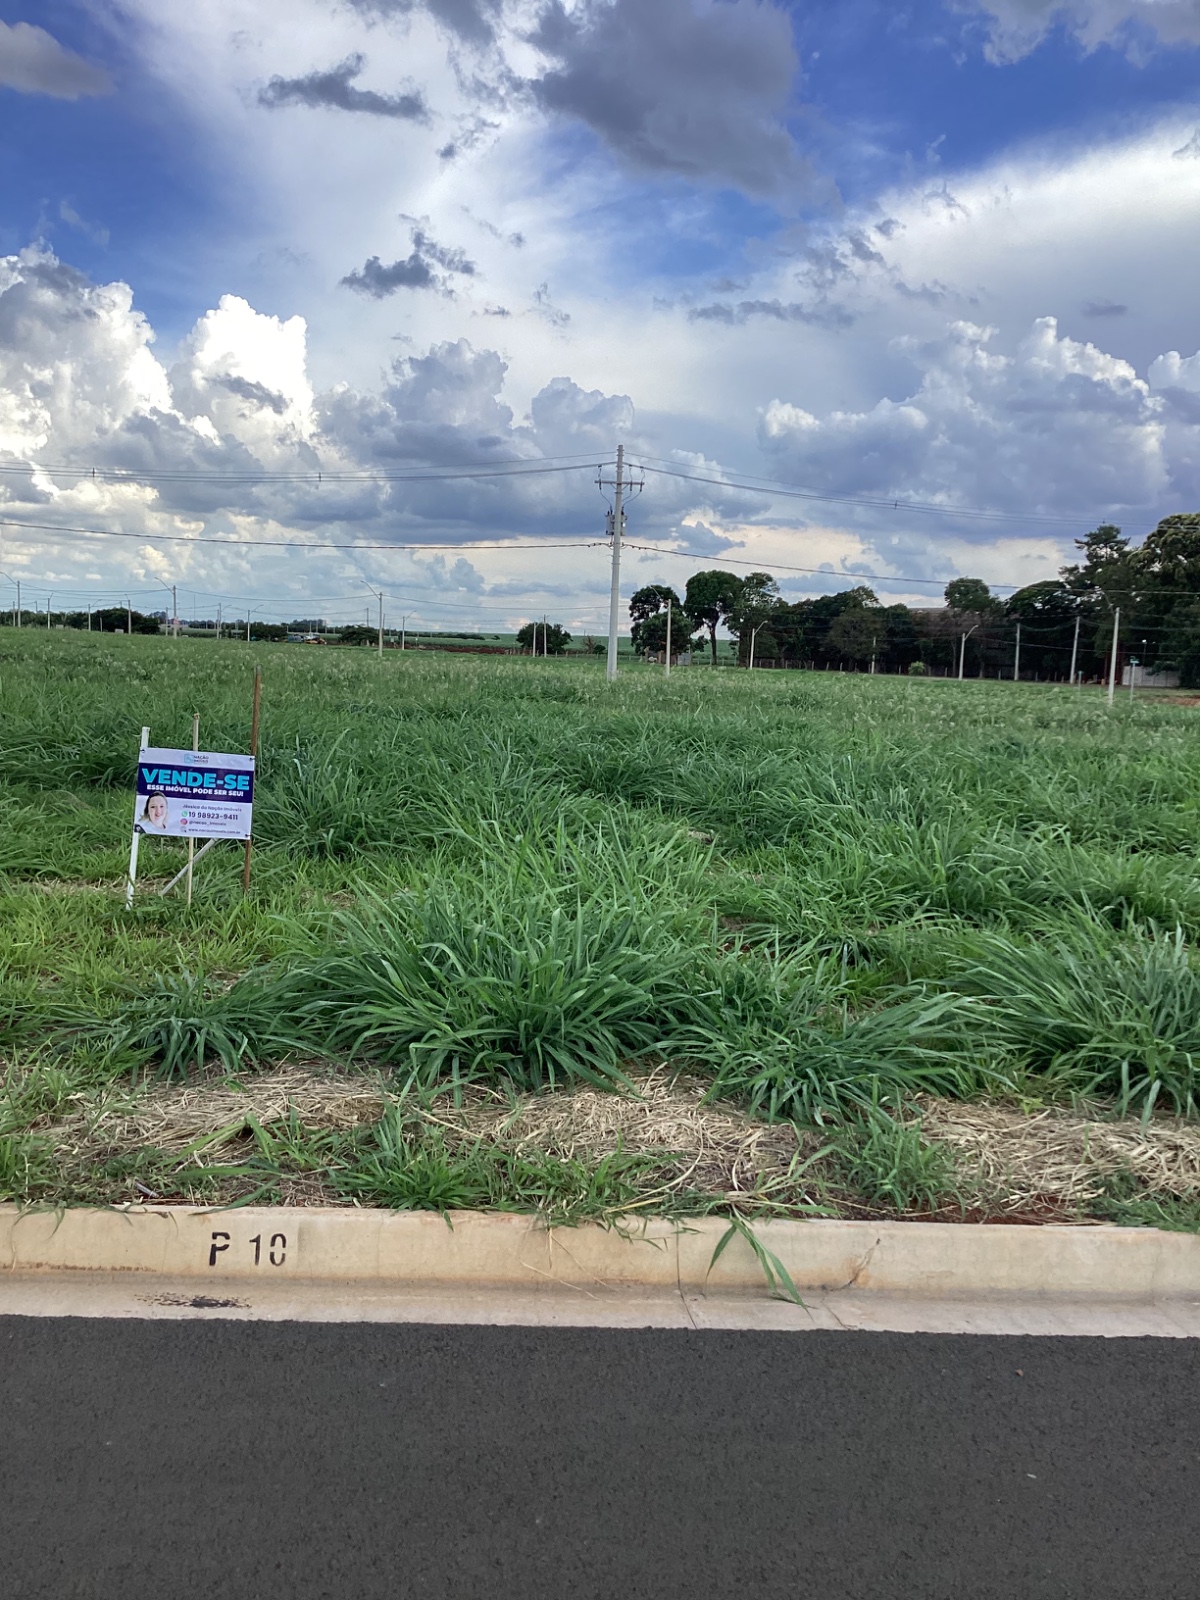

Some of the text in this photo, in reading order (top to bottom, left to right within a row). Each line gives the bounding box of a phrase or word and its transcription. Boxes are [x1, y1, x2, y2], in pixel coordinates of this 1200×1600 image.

[141, 768, 250, 790] VENDE-SE
[165, 785, 192, 793] IMÓVEL
[197, 812, 238, 820] 98923-9411
[209, 1232, 287, 1266] P 10
